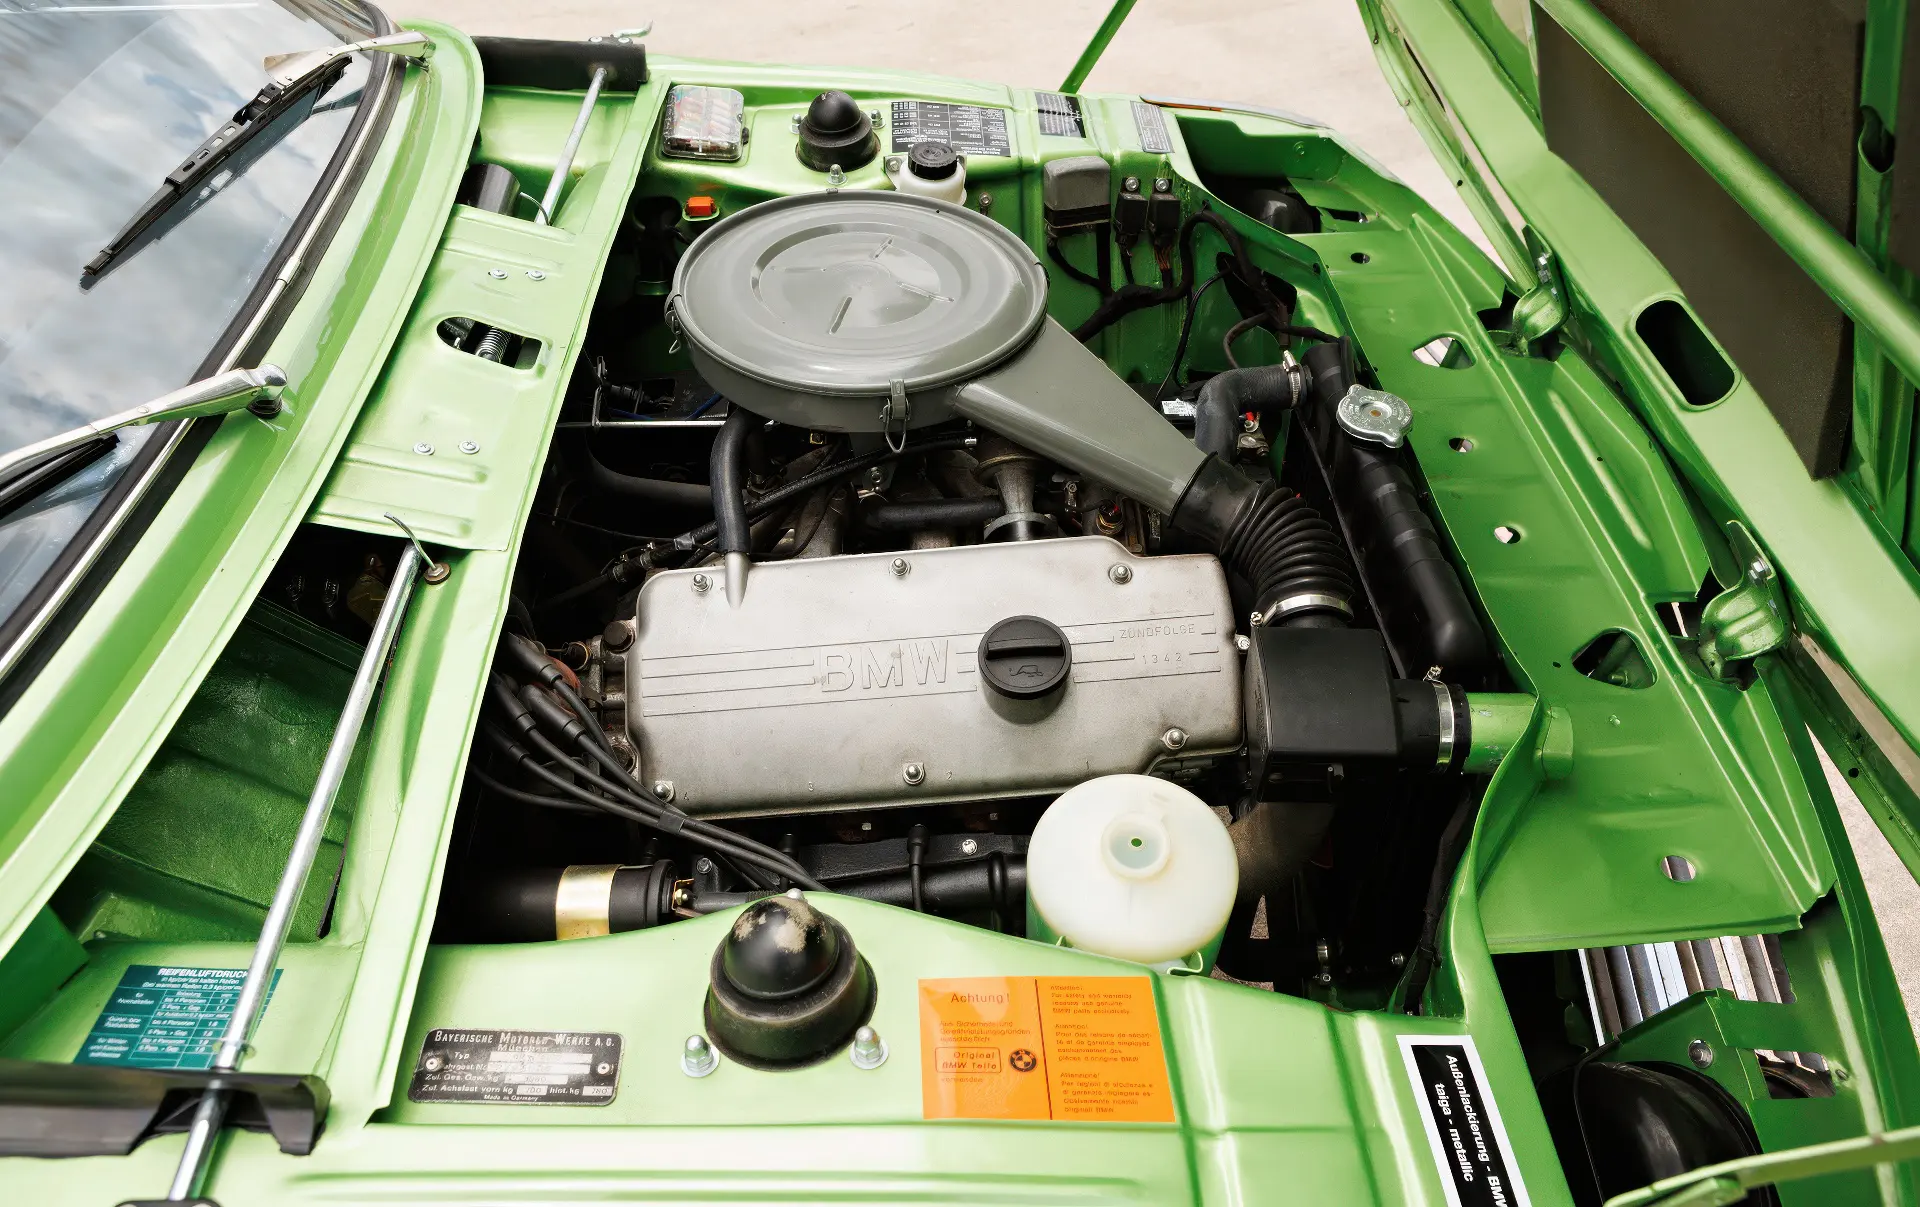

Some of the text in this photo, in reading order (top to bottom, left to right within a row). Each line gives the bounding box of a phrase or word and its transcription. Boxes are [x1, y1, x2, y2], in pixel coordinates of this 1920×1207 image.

[821, 638, 950, 693] BMW
[950, 993, 1010, 1004] Achtung!
[434, 1030, 494, 1044] BAYERISCHE
[555, 1033, 591, 1046] WERKE
[454, 1051, 470, 1060] Typ
[953, 1051, 995, 1060] Original
[942, 1061, 967, 1069] BMW
[1445, 1054, 1490, 1162] Außenlackierung
[1434, 1082, 1452, 1116] taiga
[1449, 1128, 1474, 1182] metallic
